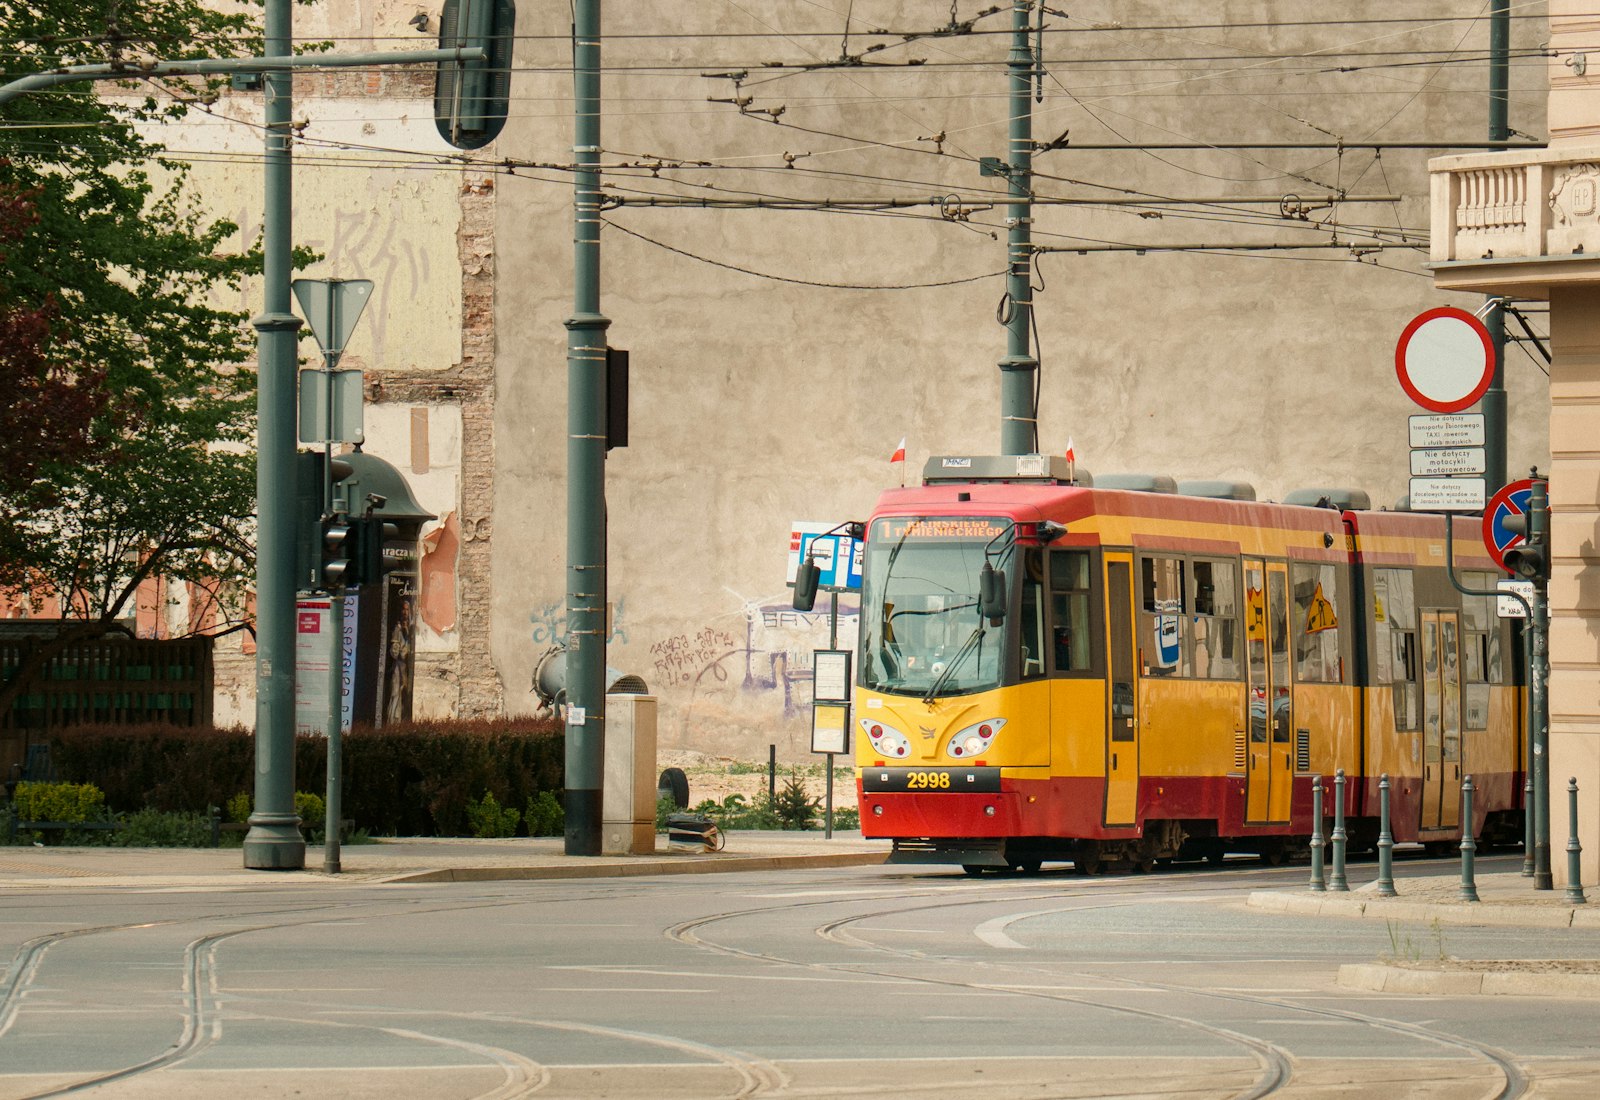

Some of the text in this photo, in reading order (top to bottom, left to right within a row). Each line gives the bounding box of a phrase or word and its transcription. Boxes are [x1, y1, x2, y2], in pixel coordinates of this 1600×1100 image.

[1441, 450, 1470, 458] dotyczy
[1429, 458, 1466, 466] motocykli
[881, 521, 891, 538] 1
[906, 771, 951, 789] 2998
